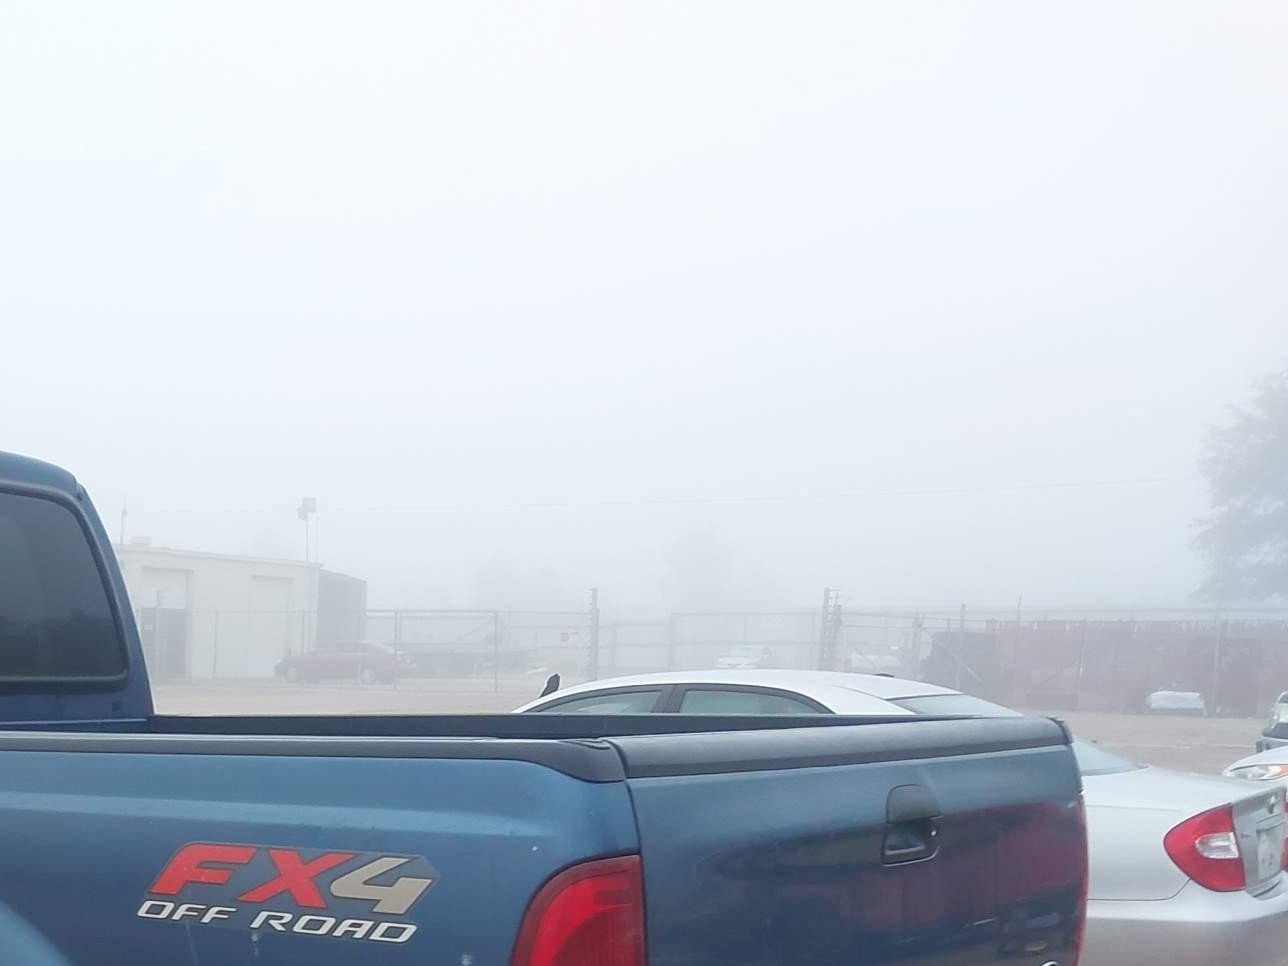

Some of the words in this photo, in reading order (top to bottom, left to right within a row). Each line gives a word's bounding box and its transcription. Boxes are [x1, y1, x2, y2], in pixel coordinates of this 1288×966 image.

[148, 842, 433, 915] FX4
[136, 900, 238, 924] OFF
[249, 911, 418, 943] ROAD
